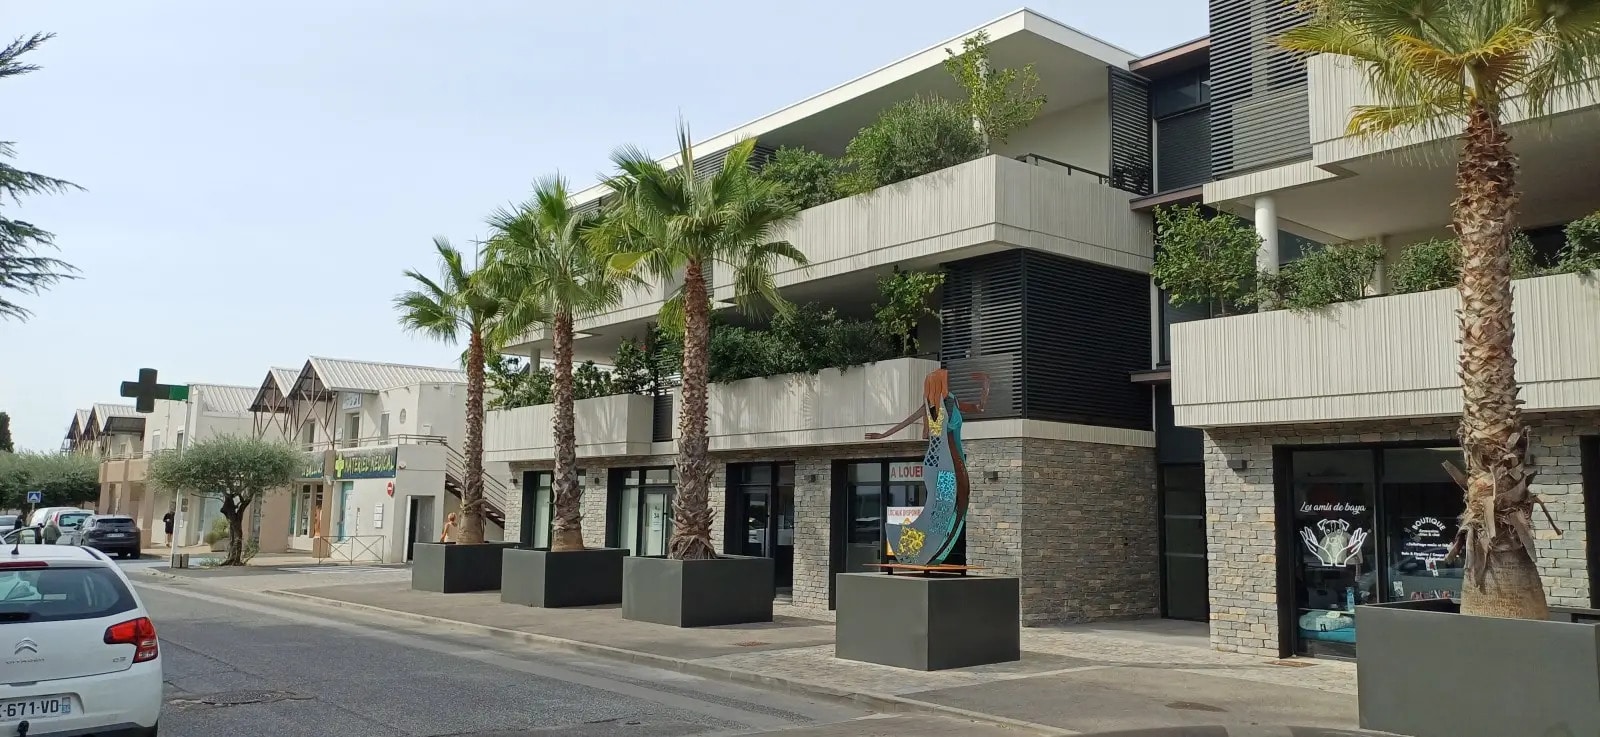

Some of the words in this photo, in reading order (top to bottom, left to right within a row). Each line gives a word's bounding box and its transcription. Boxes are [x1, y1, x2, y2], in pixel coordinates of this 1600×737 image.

[1300, 502, 1312, 513] Les
[1313, 502, 1332, 512] amis
[1332, 502, 1344, 512] de
[1344, 502, 1367, 515] baya
[1411, 516, 1447, 531] BOUTIQUE
